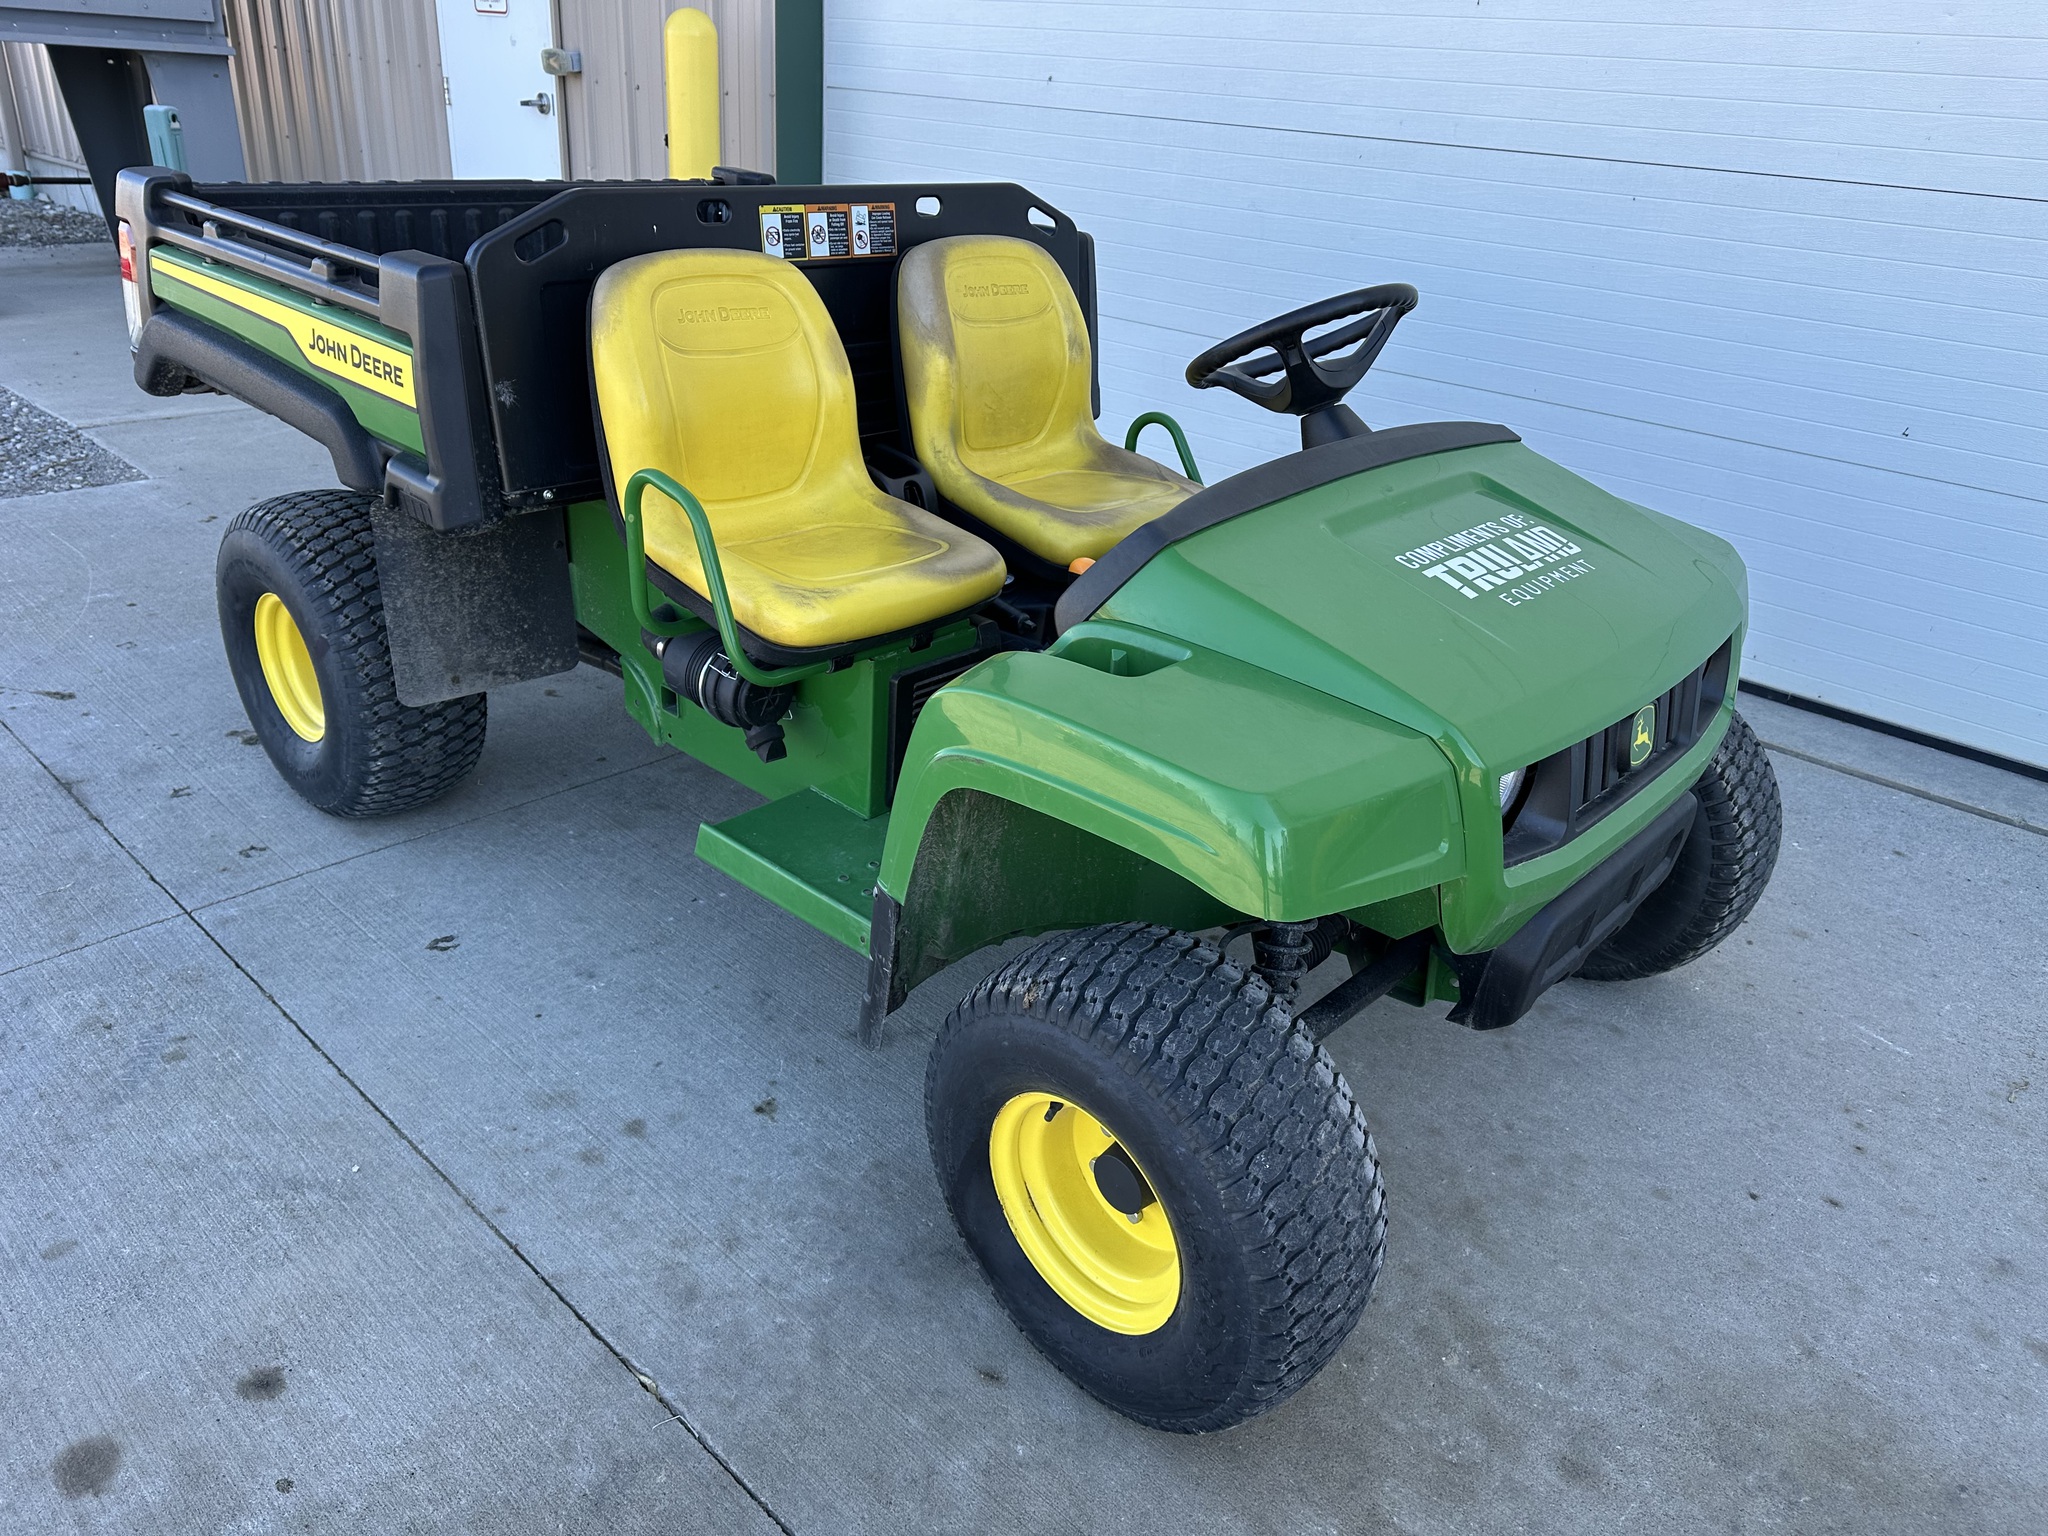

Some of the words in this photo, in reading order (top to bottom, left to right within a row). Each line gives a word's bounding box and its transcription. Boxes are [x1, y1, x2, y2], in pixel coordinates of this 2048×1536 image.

[962, 284, 990, 298] JOHN
[991, 283, 1030, 297] DEERE
[677, 308, 717, 325] JOHN
[718, 306, 771, 322] DEERE
[309, 328, 348, 365] JOHN
[350, 343, 404, 388] DEERE
[1394, 521, 1510, 569] COMPLIMENTS
[1499, 513, 1536, 529] OF:
[1498, 558, 1596, 607] EQUIPMENT
